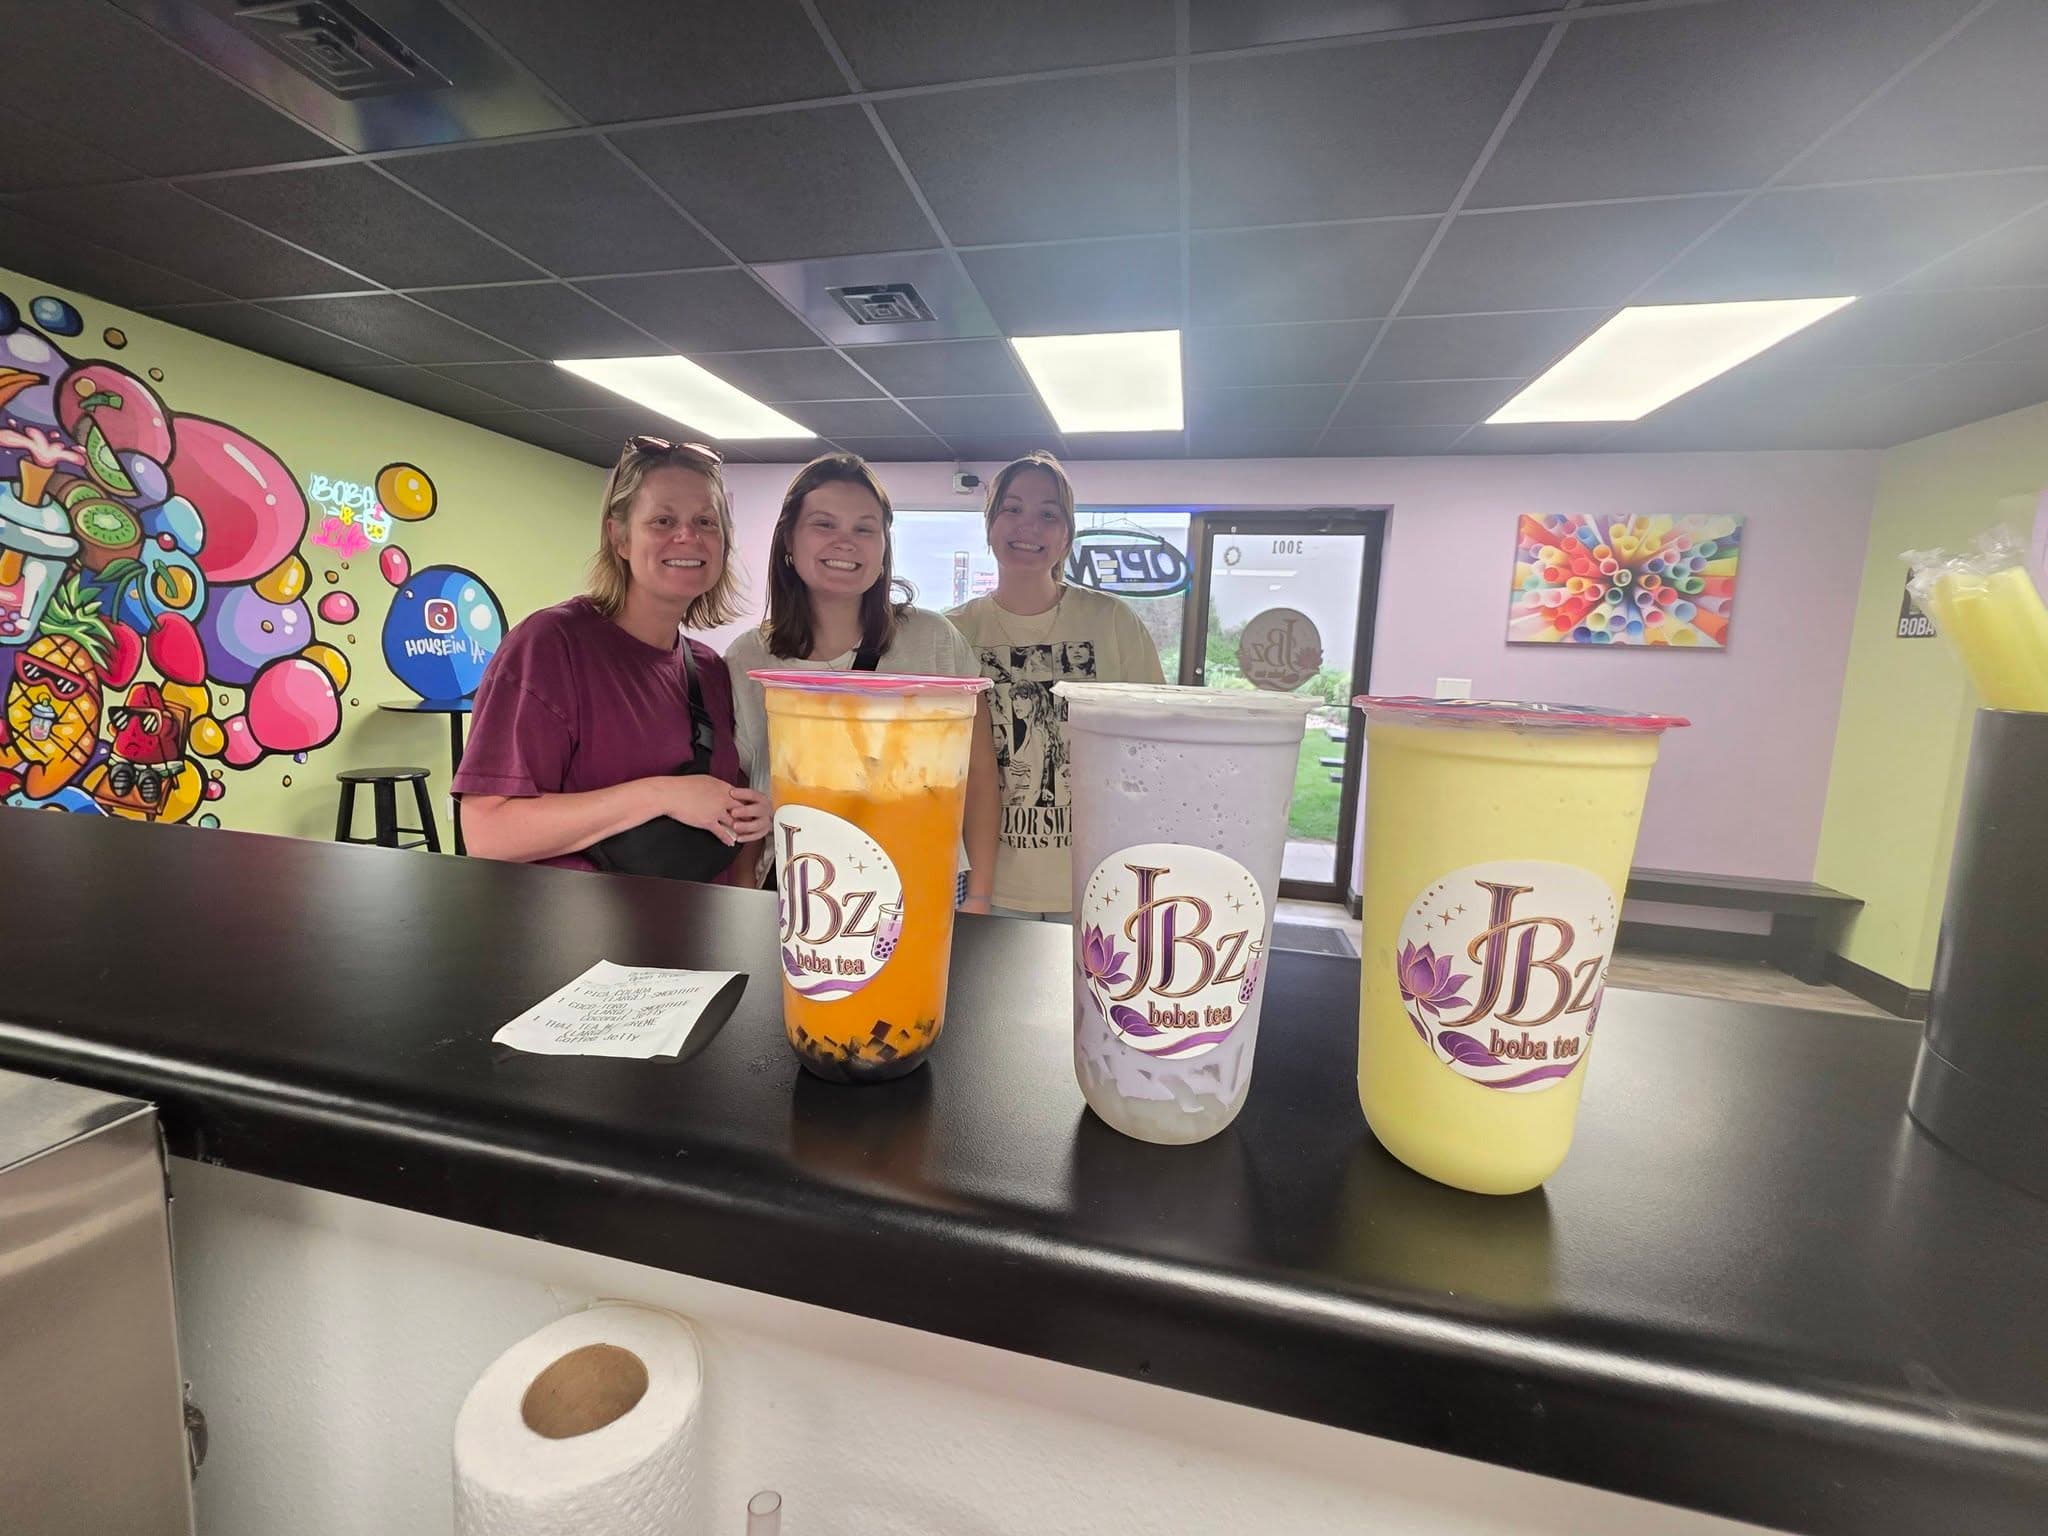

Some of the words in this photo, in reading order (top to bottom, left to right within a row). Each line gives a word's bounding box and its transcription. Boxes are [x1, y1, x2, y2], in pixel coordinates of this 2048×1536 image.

[308, 473, 376, 509] BOBA
[1898, 617, 1935, 636] BOBA
[1001, 807, 1038, 835] LOR
[796, 944, 833, 975] boba
[836, 954, 866, 976] tea
[1148, 1000, 1200, 1029] boba
[1204, 1004, 1233, 1028] tea
[1487, 1028, 1548, 1061] boba
[1552, 1035, 1580, 1059] tea
